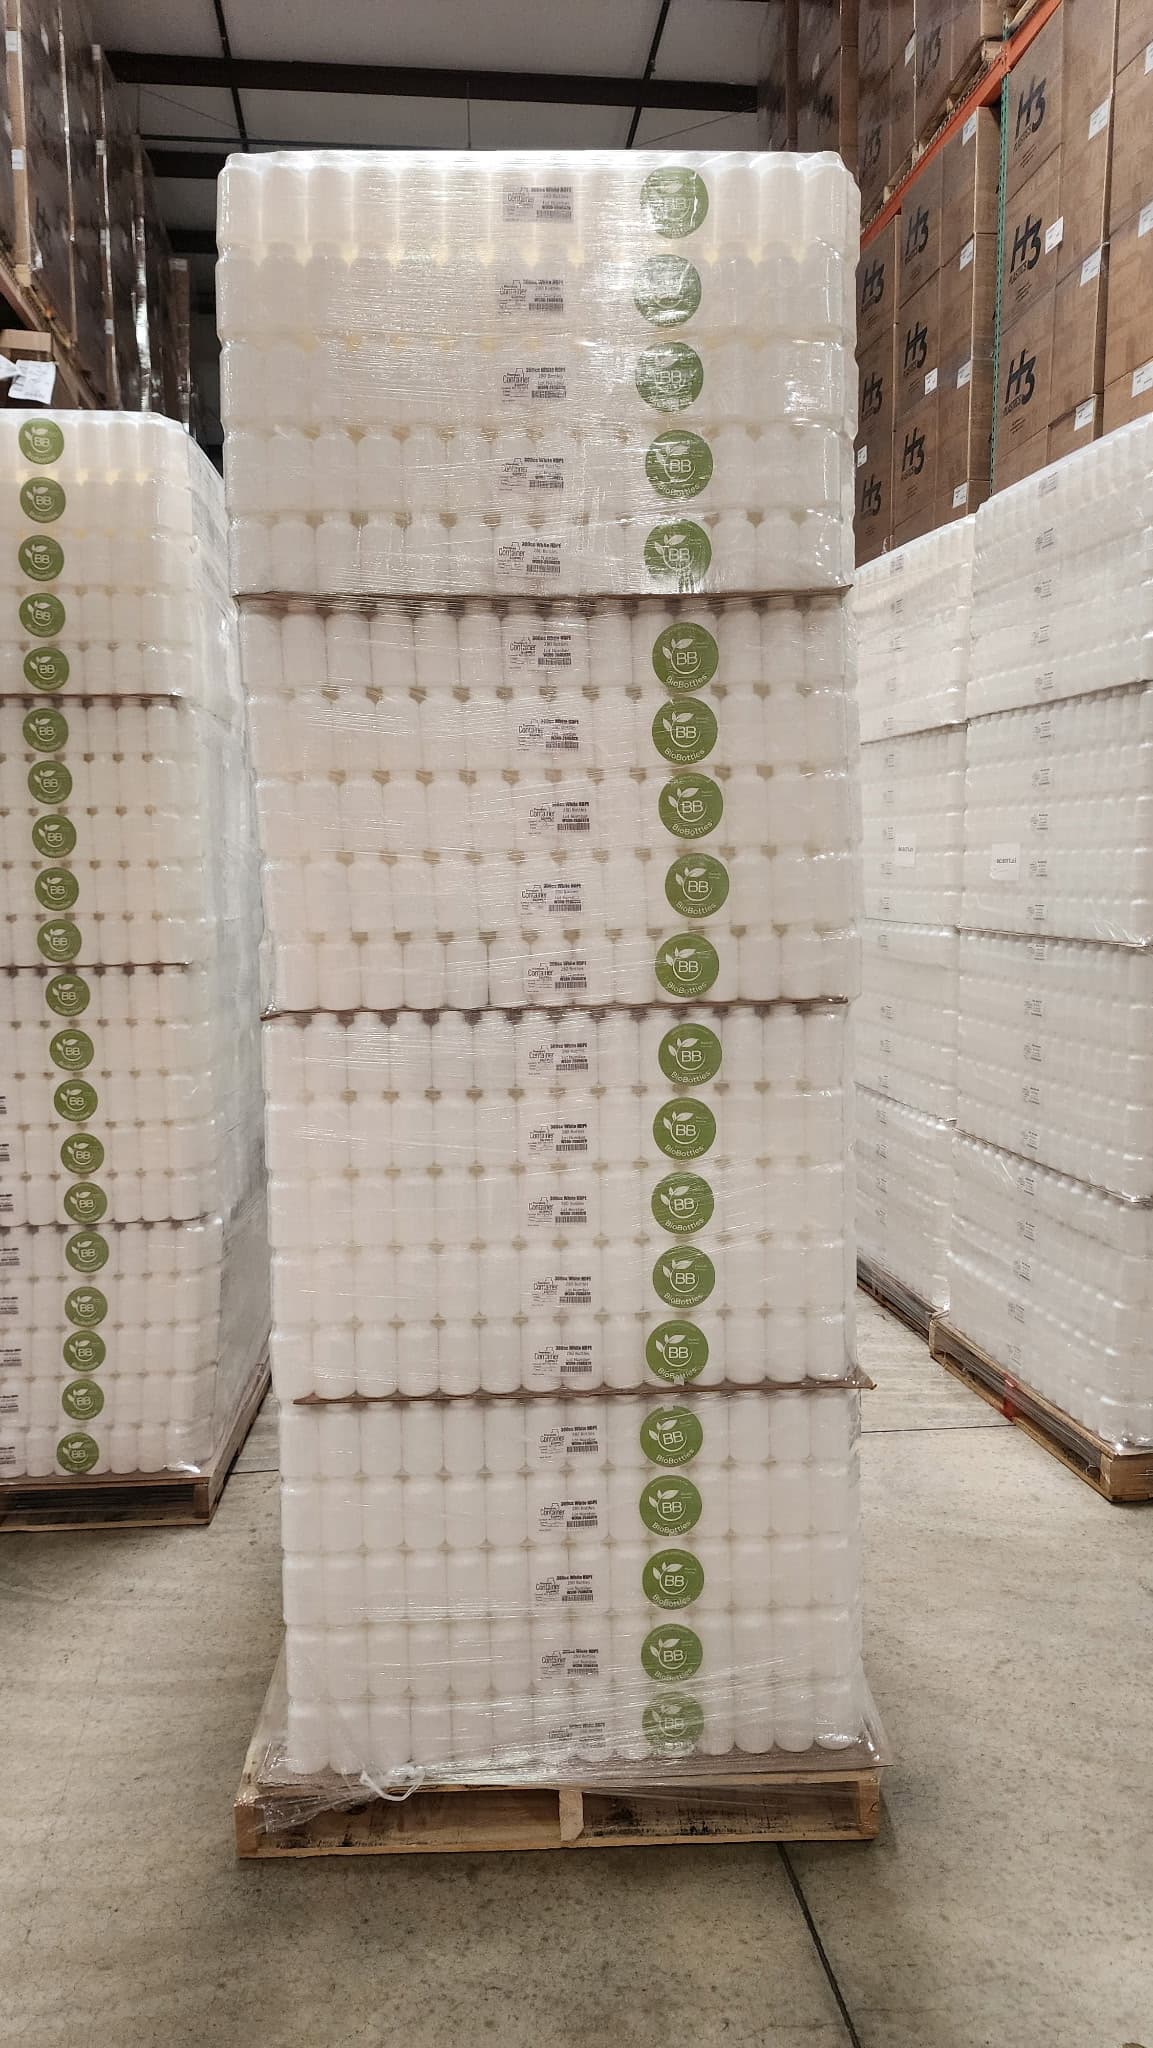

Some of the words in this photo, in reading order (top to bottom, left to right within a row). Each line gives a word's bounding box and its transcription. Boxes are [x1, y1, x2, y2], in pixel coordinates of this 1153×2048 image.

[1015, 75, 1046, 140] H3
[905, 206, 929, 256] H3
[1010, 214, 1042, 274] H3
[862, 260, 884, 304] H3
[904, 322, 927, 369] H3
[660, 370, 682, 383] BB
[1005, 349, 1036, 405] H3
[862, 371, 883, 417] H3
[902, 426, 926, 475] H3
[670, 459, 691, 472] BB
[862, 474, 882, 516] H3
[669, 548, 690, 561] BB
[677, 652, 697, 665] BB
[666, 674, 708, 689] BioBottles
[676, 726, 697, 739] BB
[664, 748, 704, 761] BioBottles
[682, 800, 703, 813] BB
[672, 821, 713, 836] BioBottles
[688, 880, 708, 893] BB
[676, 902, 717, 915] BioBottles
[679, 960, 699, 972] BB
[667, 982, 707, 994] BioBottles
[682, 1051, 702, 1062] BB
[671, 1071, 711, 1083] BioBottles
[676, 1125, 696, 1136] BB
[665, 1144, 704, 1157] BioBottles
[674, 1198, 694, 1210] BB
[665, 1218, 704, 1231] BioBottles
[676, 1272, 695, 1285] BB
[664, 1292, 704, 1306] BioBottles
[668, 1347, 688, 1359] BB
[663, 1431, 684, 1445] BB
[656, 1448, 695, 1464] BioBottles
[662, 1501, 682, 1514] BB
[652, 1521, 691, 1535] BioBottles
[665, 1575, 684, 1587] BB
[663, 1650, 683, 1662] BB
